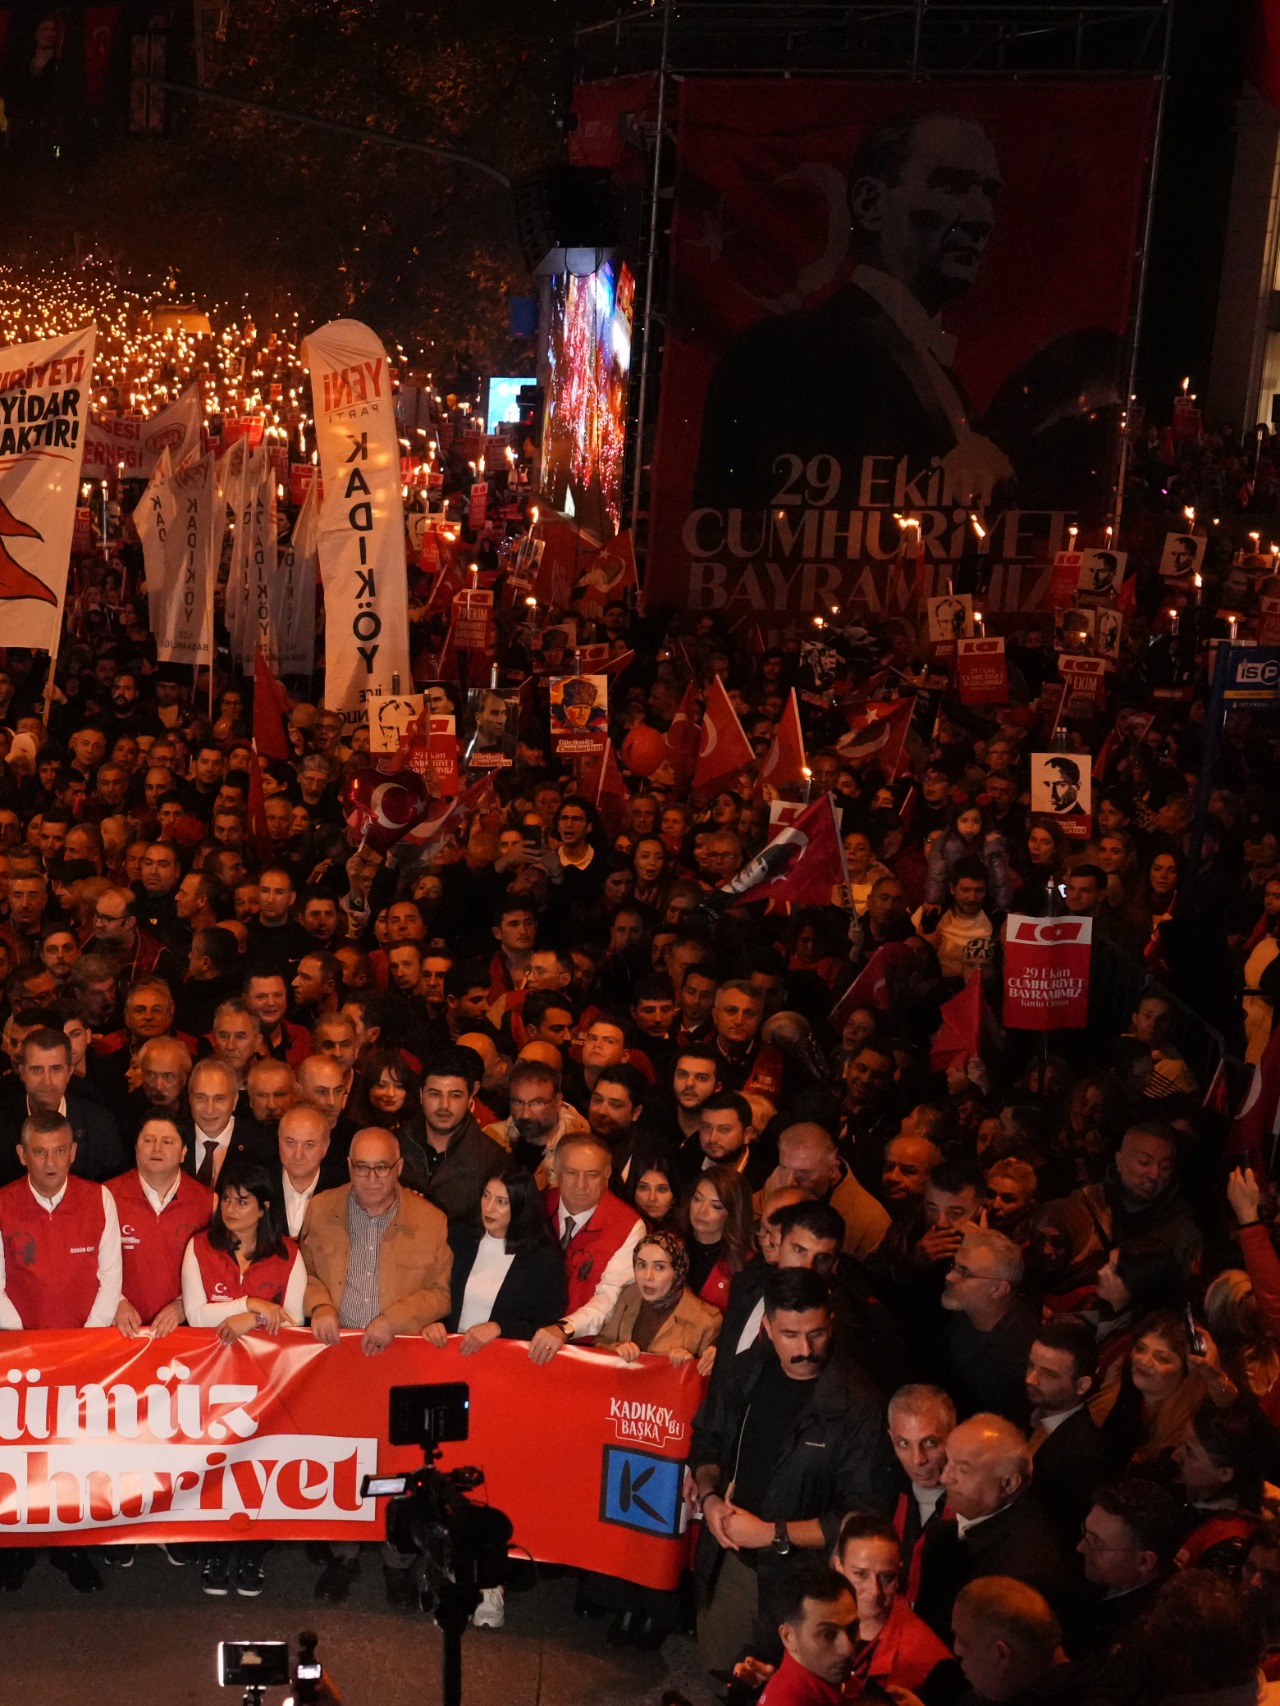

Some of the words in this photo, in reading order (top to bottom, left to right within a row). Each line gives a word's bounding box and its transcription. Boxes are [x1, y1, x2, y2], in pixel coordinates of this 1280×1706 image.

[83, 440, 143, 469] ERNEĞİ
[770, 452, 842, 507] 29
[1007, 978, 1083, 990] CUMHURİYET
[1022, 967, 1038, 979] 29
[609, 1396, 674, 1427] KADIKÖY
[621, 1419, 660, 1442] BAŞKA
